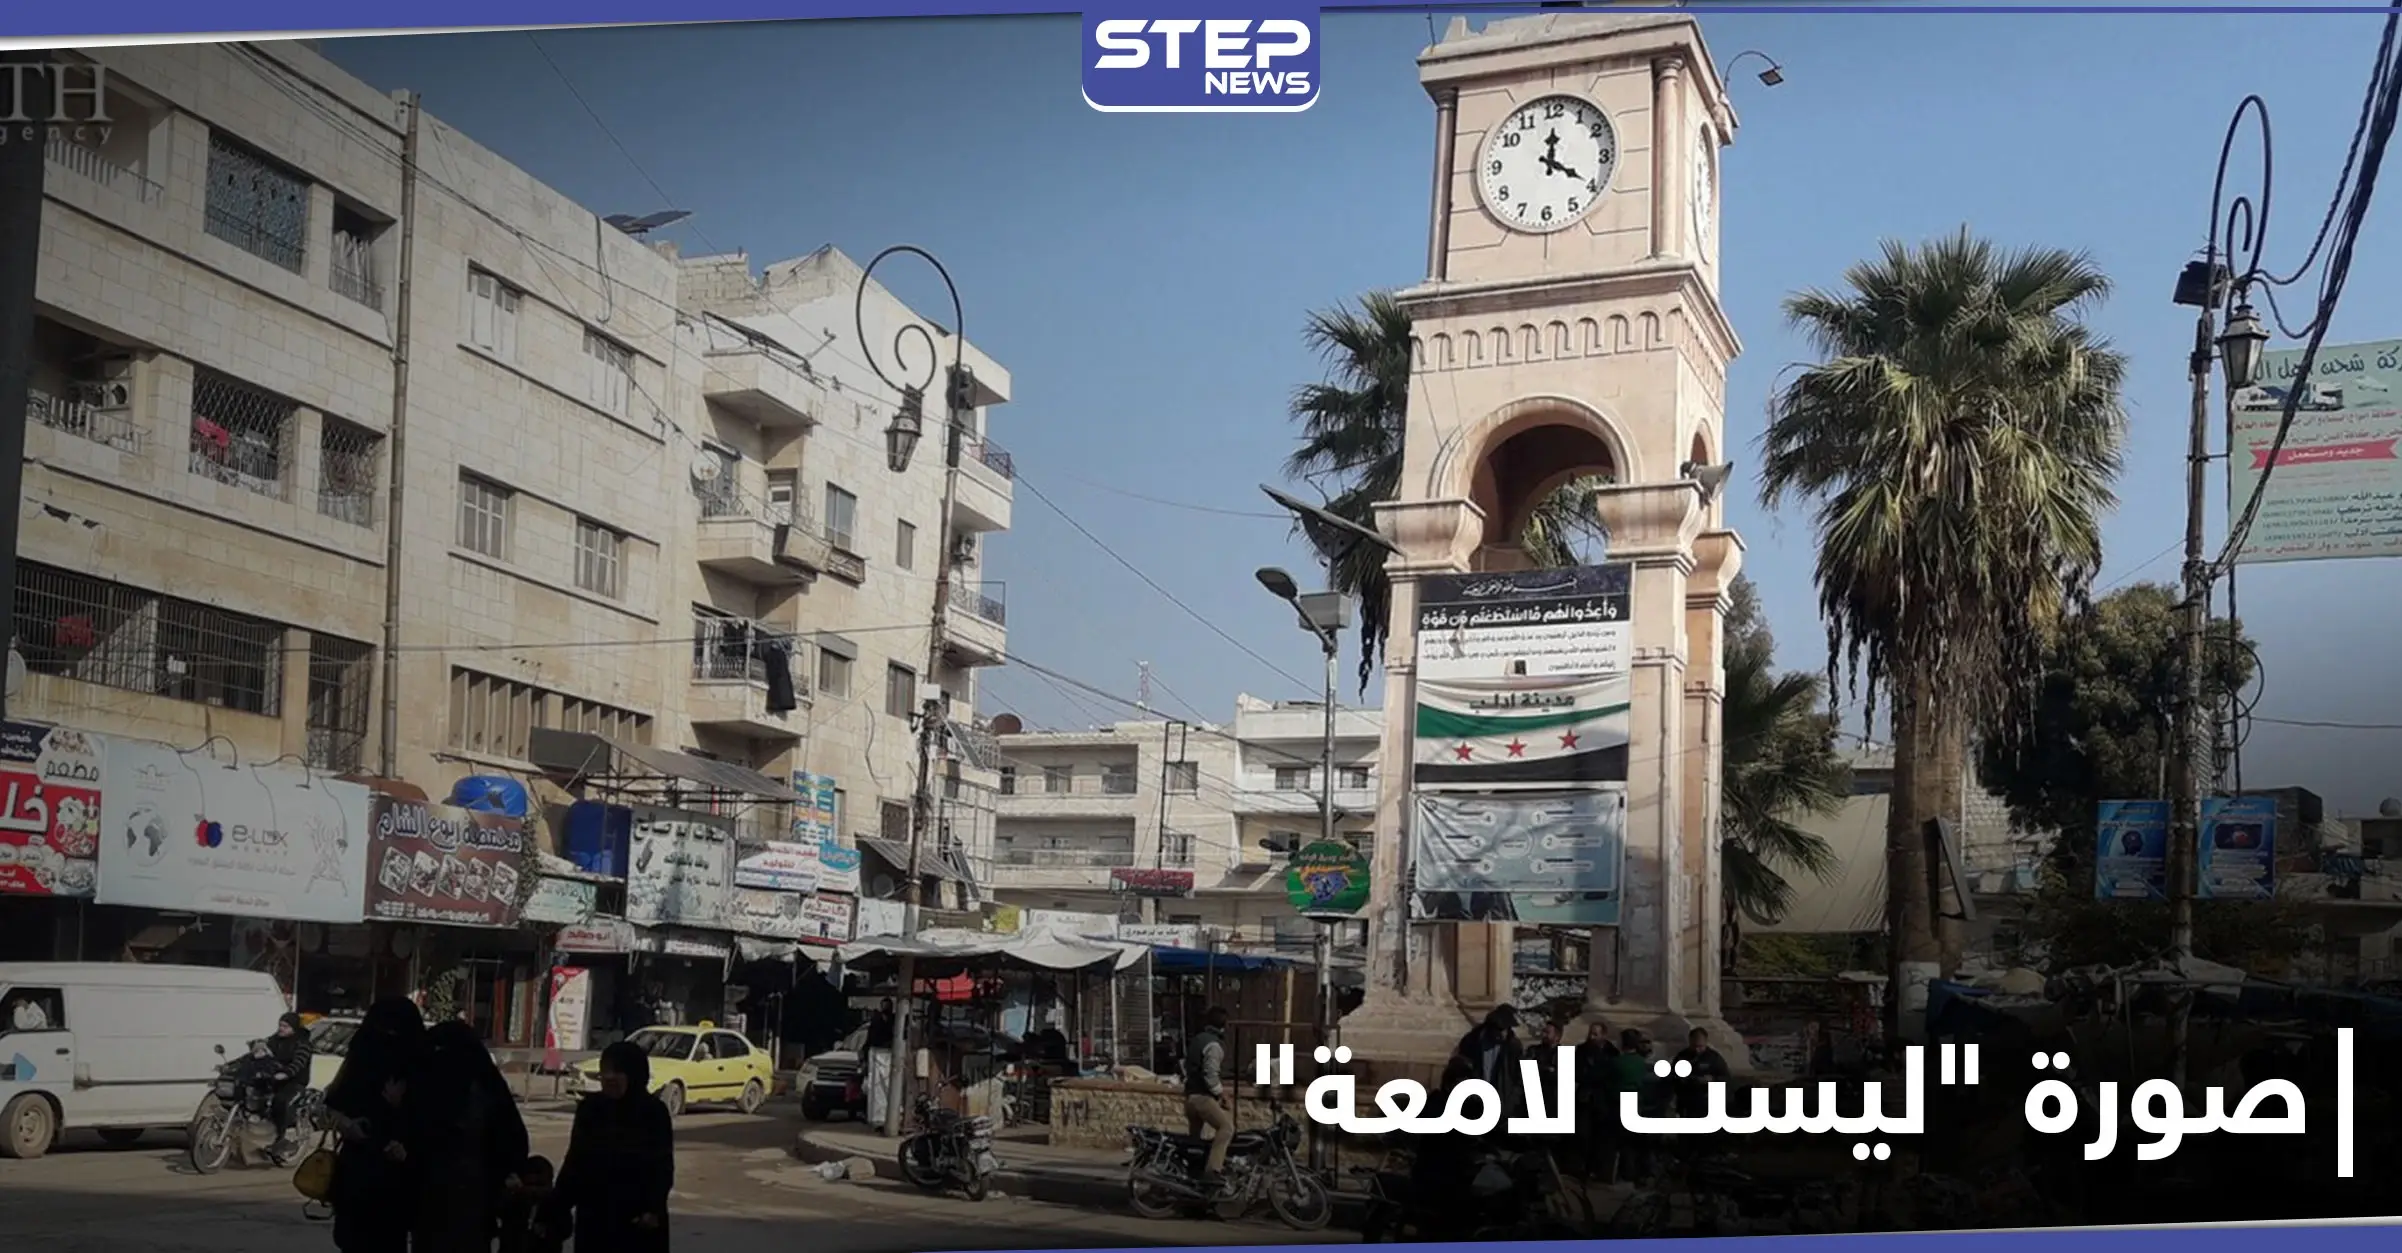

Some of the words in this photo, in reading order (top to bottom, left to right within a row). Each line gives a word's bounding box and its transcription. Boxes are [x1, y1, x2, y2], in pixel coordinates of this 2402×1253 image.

[1544, 103, 1564, 120] 12
[1576, 108, 1584, 125] 1
[1519, 115, 1536, 130] 11
[1590, 123, 1603, 139] 2
[1502, 132, 1521, 148] 10
[1598, 148, 1610, 165] 3
[1491, 160, 1503, 175] 9
[1499, 185, 1510, 201] 8
[1586, 178, 1598, 193] 4
[1516, 202, 1528, 218] 7
[1540, 205, 1553, 221] 6
[1567, 197, 1579, 213] 5
[2320, 353, 2365, 375] شحن
[2377, 346, 2402, 371] ركة
[2335, 447, 2365, 457] جديد
[1519, 692, 1576, 713] مدينة
[44, 759, 100, 781] مطعم
[376, 802, 428, 841] الشام
